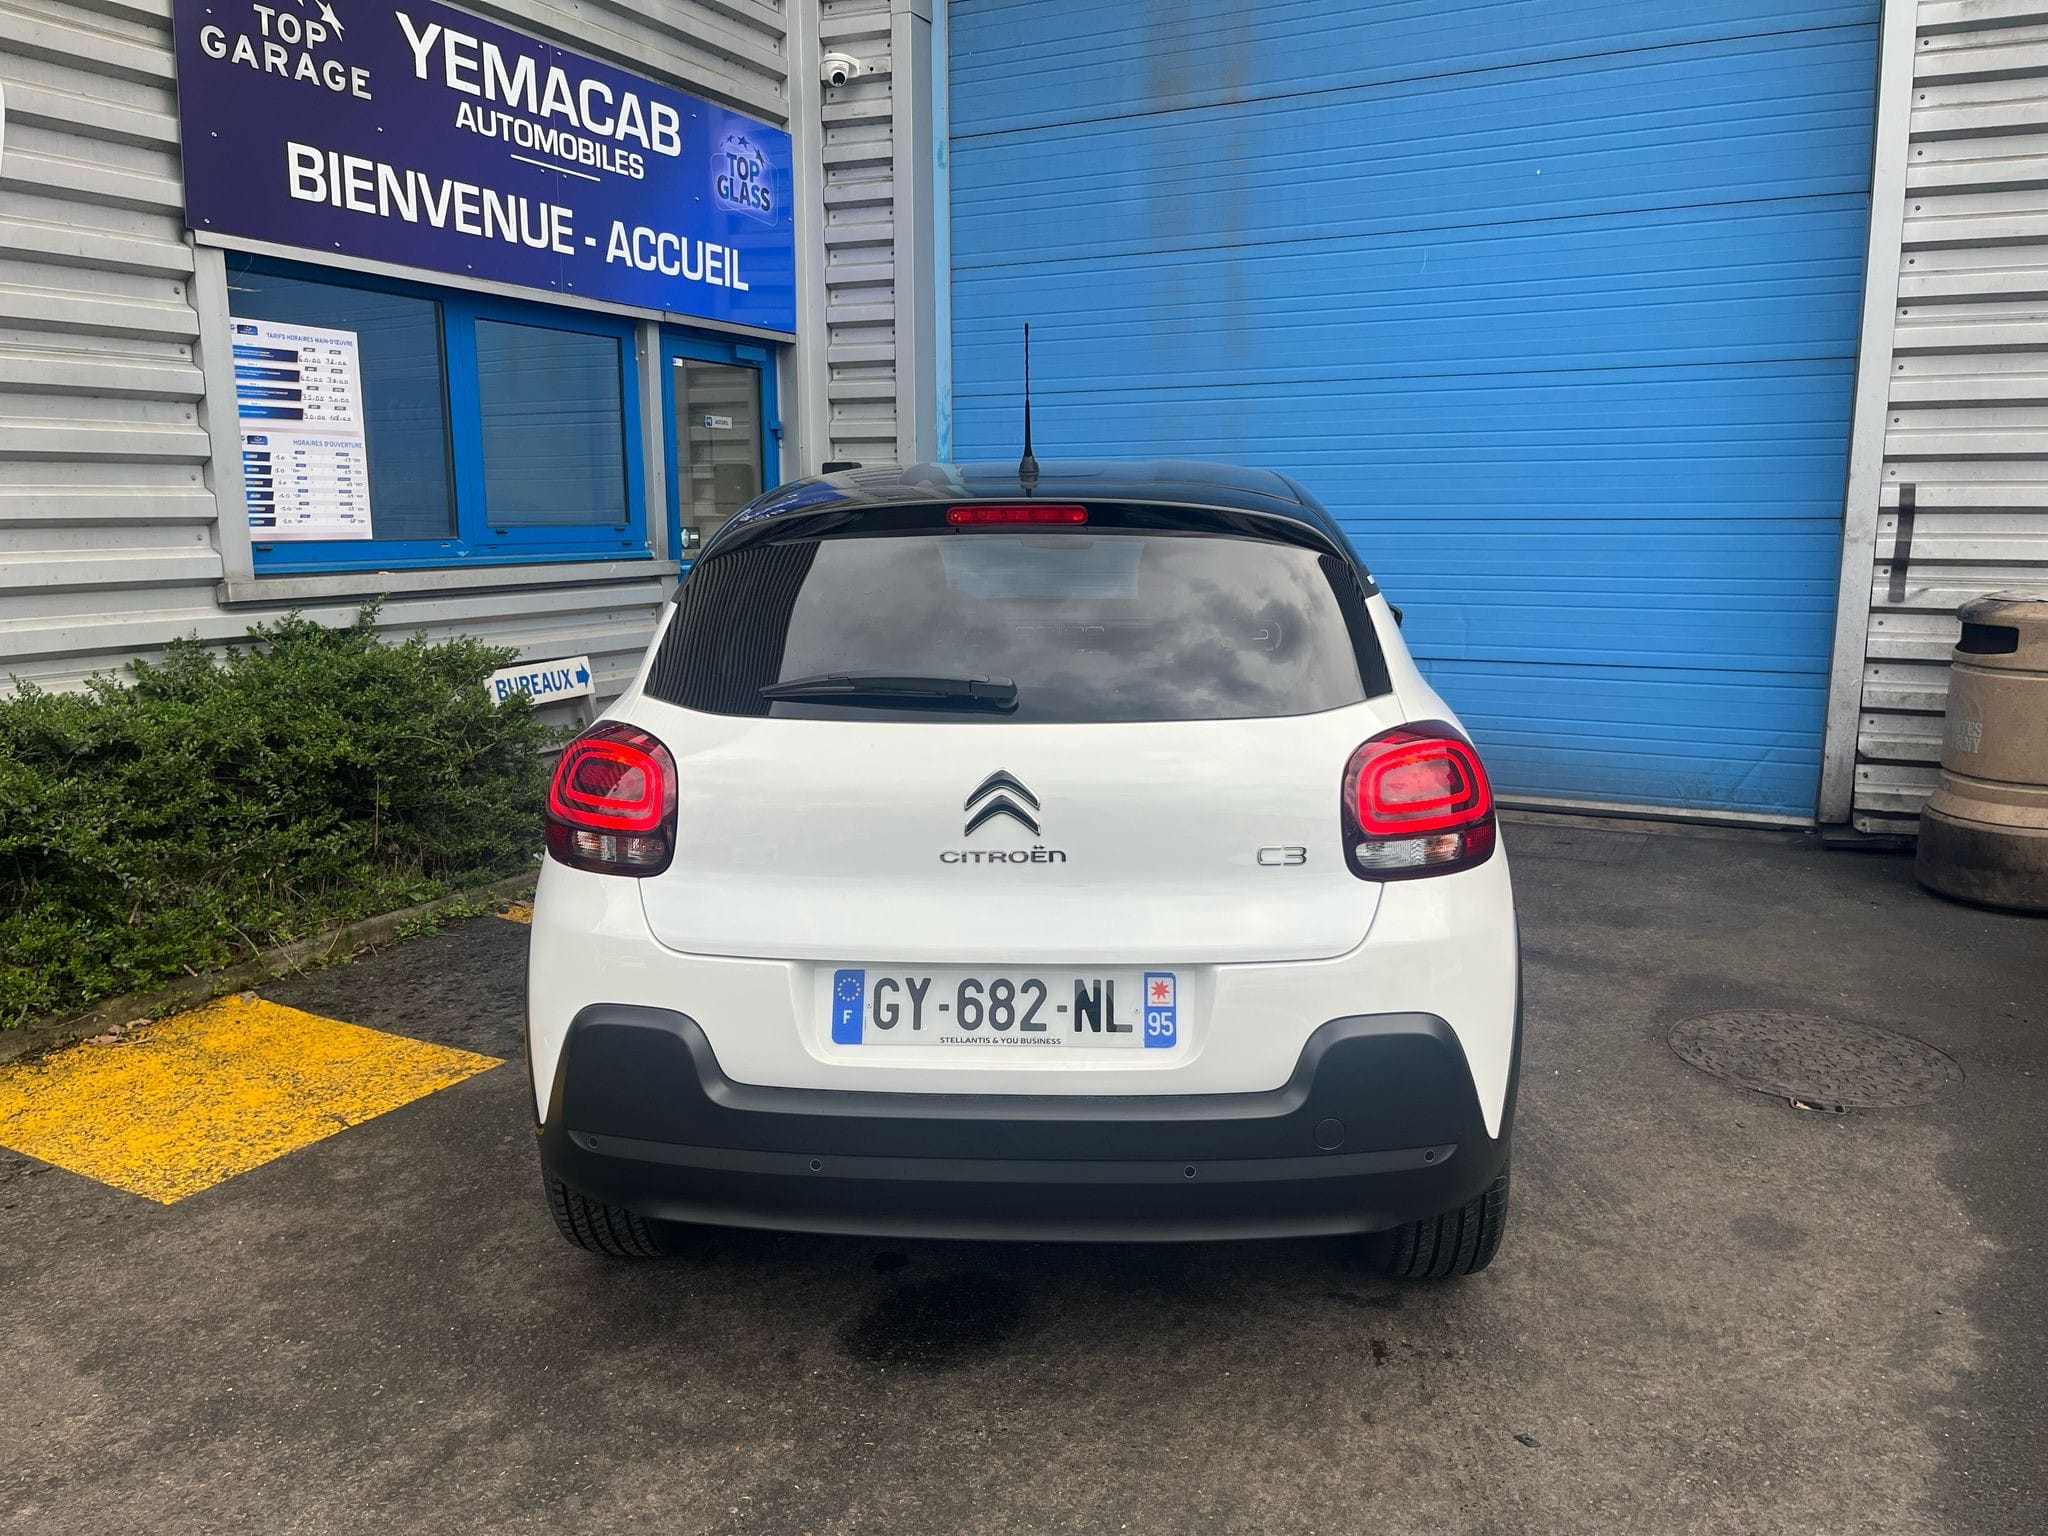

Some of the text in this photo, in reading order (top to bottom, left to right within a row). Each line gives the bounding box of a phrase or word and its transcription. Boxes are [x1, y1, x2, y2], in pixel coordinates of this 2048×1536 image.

[253, 4, 327, 49] TOP
[200, 25, 372, 100] GARAGE
[396, 11, 682, 158] YEMACAB
[456, 102, 645, 180] AUTOMOBILES
[726, 152, 760, 182] TOP
[717, 174, 771, 211] GLASS
[287, 141, 575, 256] BIENVENUE
[606, 220, 749, 292] ACCUEIL
[266, 332, 286, 340] TARIFS
[286, 335, 314, 343] HORAIRES
[293, 439, 363, 449] HORAIRES D'OUVERTURE
[495, 668, 575, 701] BUREAUX
[940, 845, 1067, 864] CITROËN
[1257, 845, 1308, 866] C3
[843, 1009, 853, 1024] F
[872, 977, 1134, 1033] GY-682-NL
[1148, 1011, 1174, 1036] 95
[940, 1036, 991, 1044] STELLANTIS
[1020, 1037, 1062, 1045] BUSINESS
